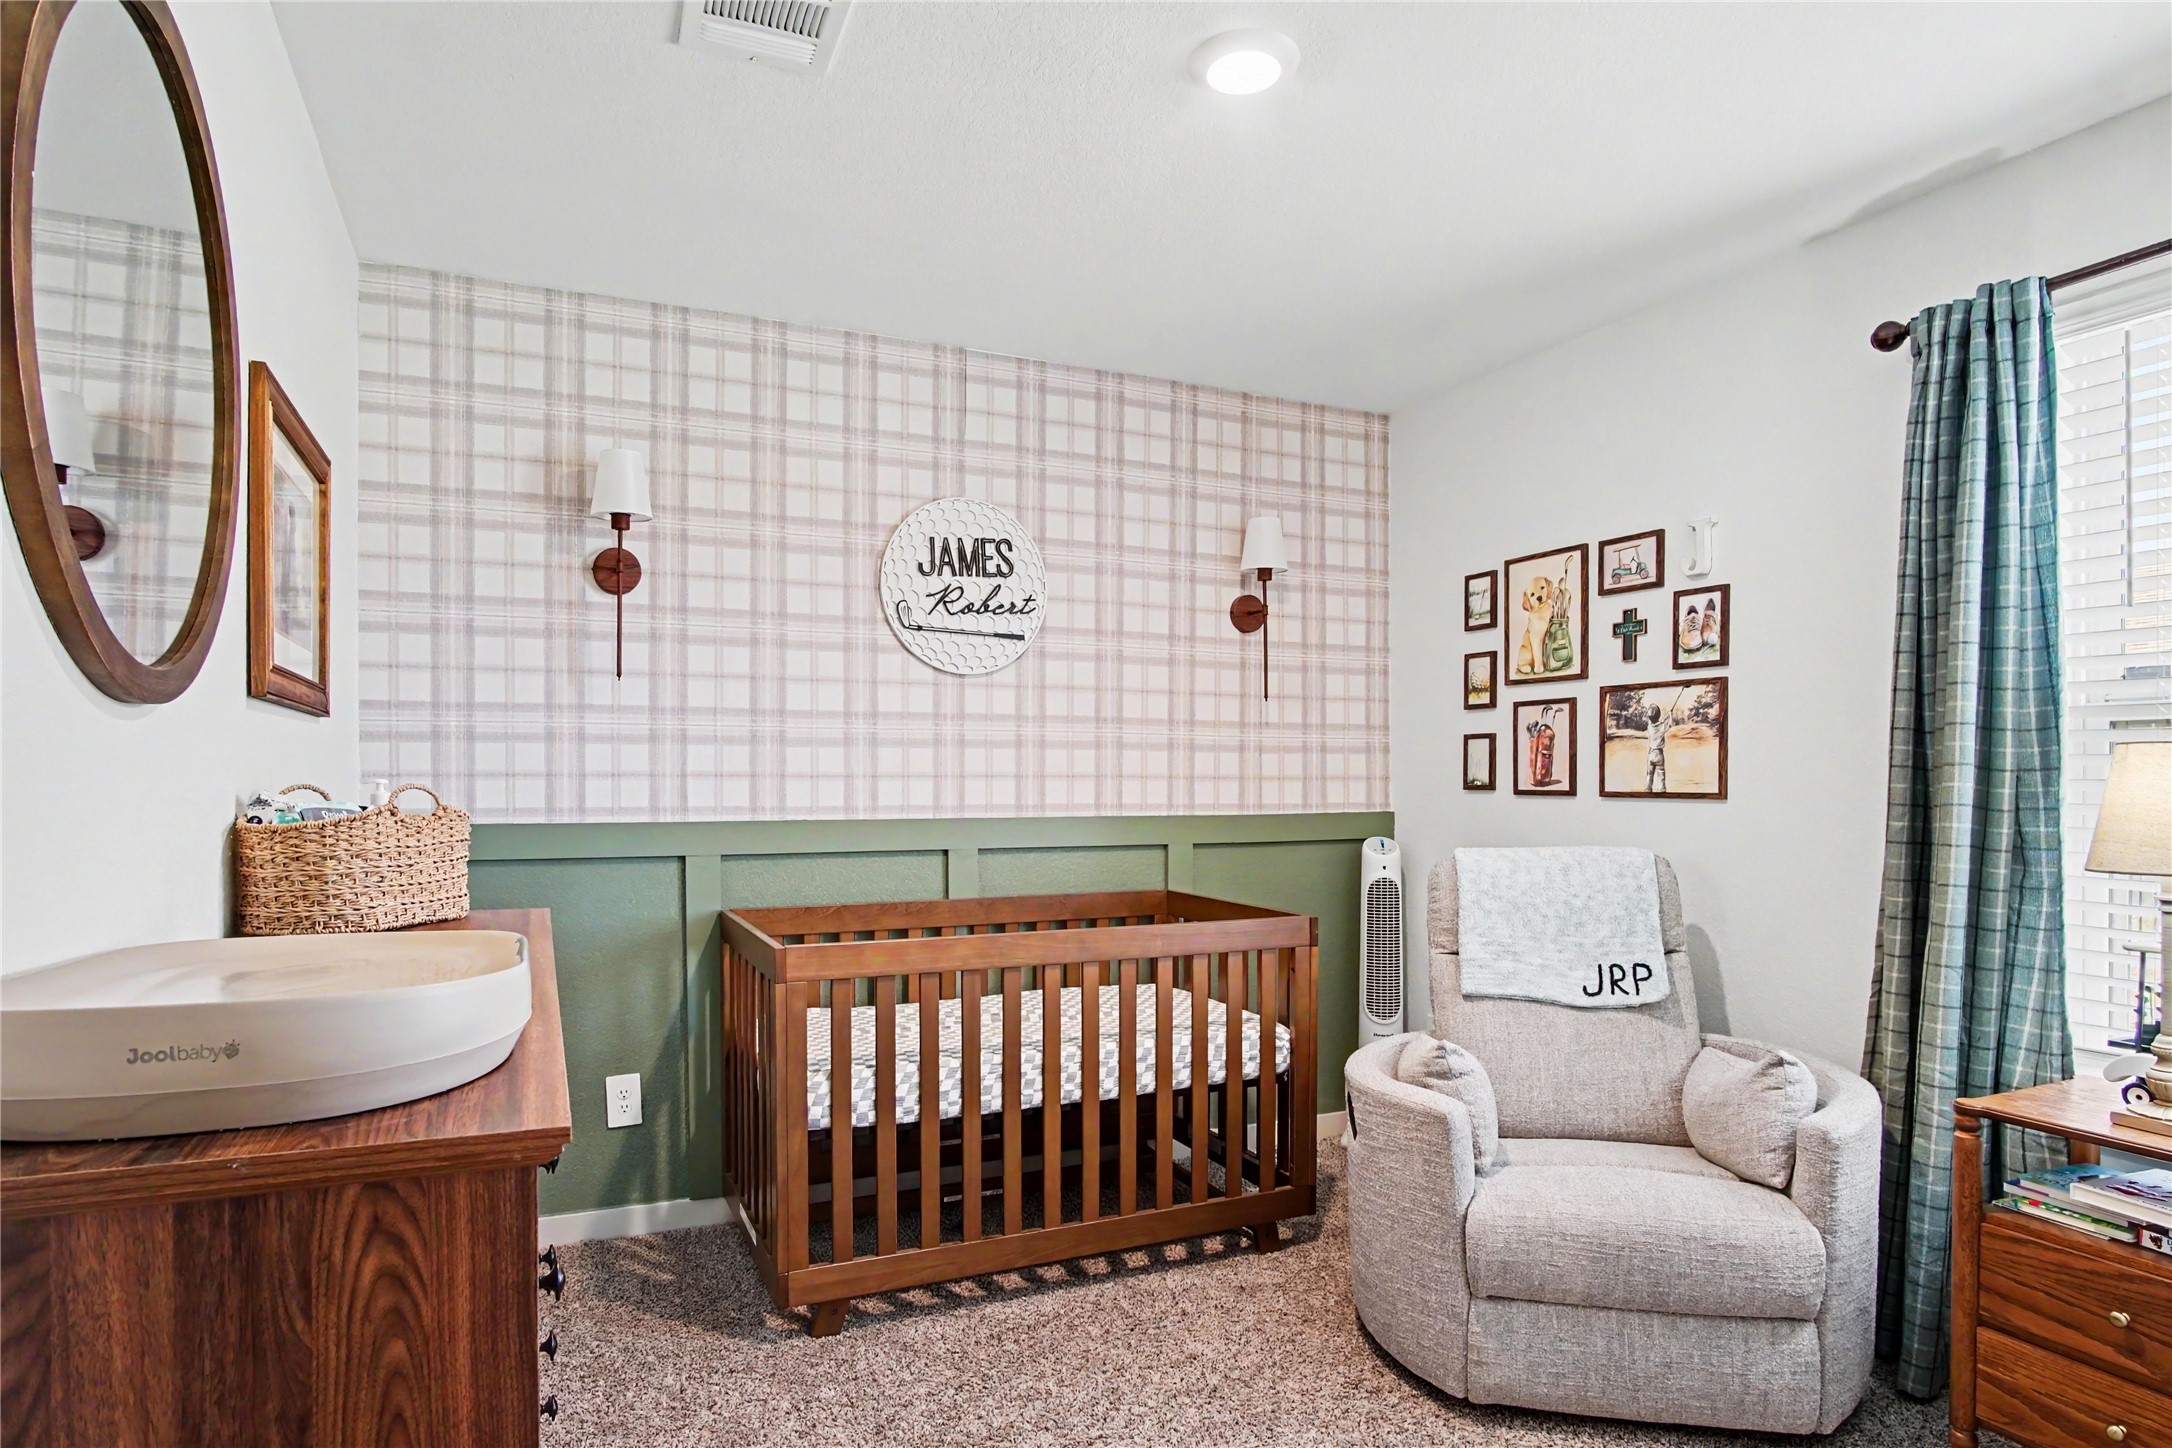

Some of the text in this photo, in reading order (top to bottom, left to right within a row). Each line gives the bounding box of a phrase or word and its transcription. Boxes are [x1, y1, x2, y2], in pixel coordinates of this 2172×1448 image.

[917, 536, 1014, 578] JAMES
[926, 583, 1037, 616] Robert
[1582, 962, 1652, 997] JRP
